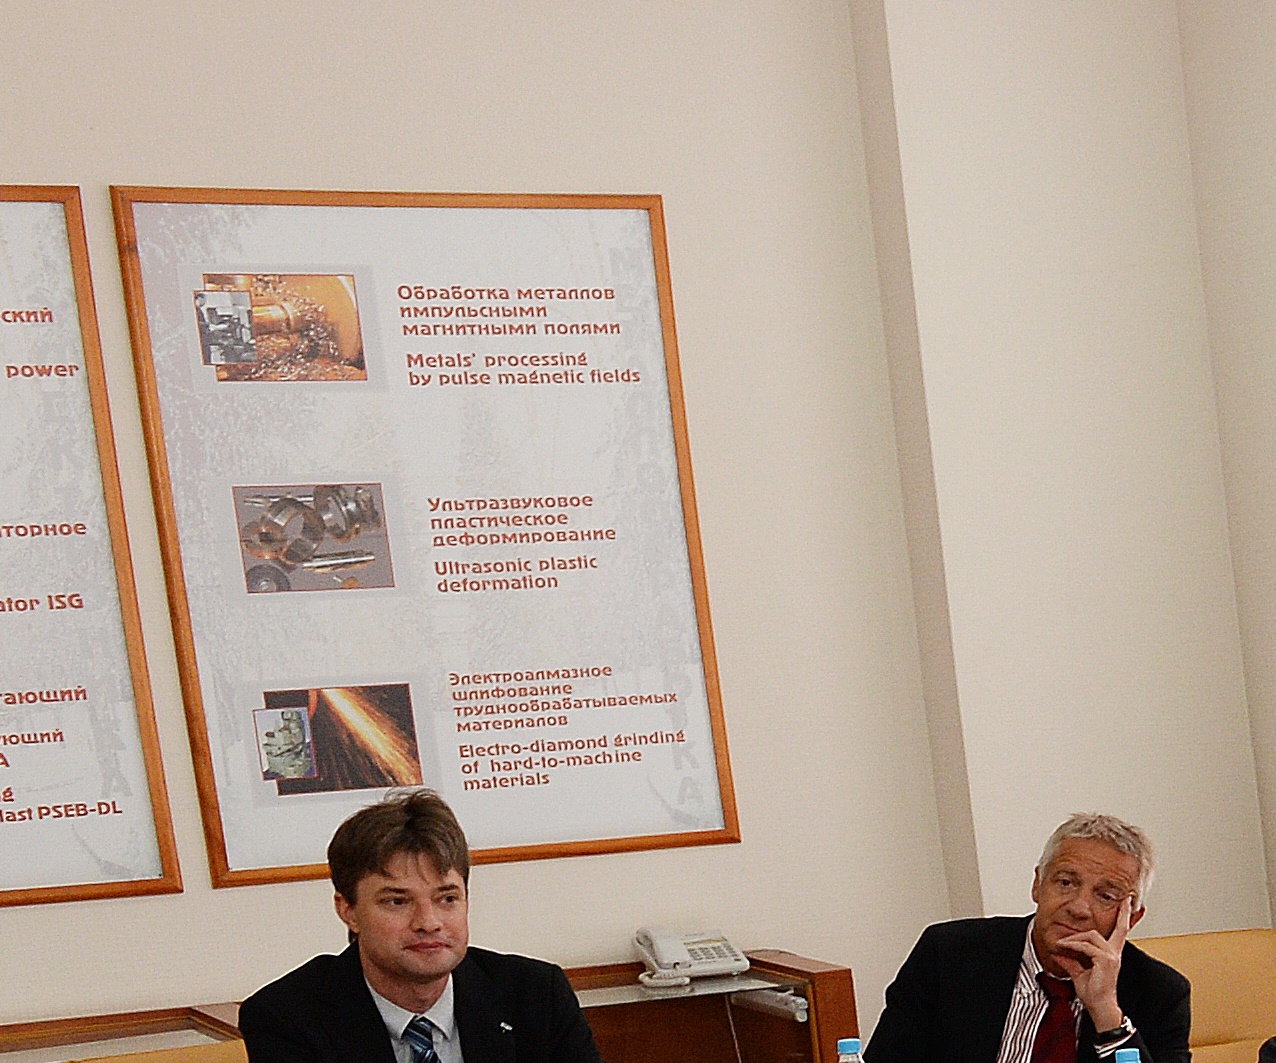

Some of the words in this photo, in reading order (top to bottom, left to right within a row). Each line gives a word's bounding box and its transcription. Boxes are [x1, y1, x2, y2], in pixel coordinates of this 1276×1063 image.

[397, 285, 510, 300] Обработка
[517, 288, 615, 299] металлов
[400, 306, 547, 318] импульсными
[403, 323, 537, 336] магнитными
[544, 323, 621, 335] полями
[484, 353, 587, 367] processing
[6, 364, 79, 378] power
[409, 372, 432, 386] by
[439, 372, 491, 385] pulse
[498, 370, 585, 385] magnetic
[590, 369, 641, 383] fields
[428, 495, 593, 512] Ультразвуковое
[431, 513, 568, 529] пластическое
[0, 522, 87, 538] торное
[433, 529, 616, 547] деформирование
[434, 557, 535, 576] Ultrasonic
[538, 556, 598, 572] plastic
[437, 576, 559, 593] deformation
[47, 593, 84, 610] ISG
[449, 666, 612, 685] Электроалмазное
[0, 685, 88, 706] ающий
[454, 684, 574, 702] шлифование
[456, 693, 678, 716] труднообрабатываемых
[456, 715, 568, 732] материалов
[0, 729, 65, 746] ющий
[459, 735, 608, 758] Electro-diamond
[613, 729, 686, 746] grinding
[461, 761, 479, 774] of
[490, 751, 641, 771] hard-to-machine
[464, 774, 550, 789] materials
[37, 801, 123, 820] PSEB-DL
